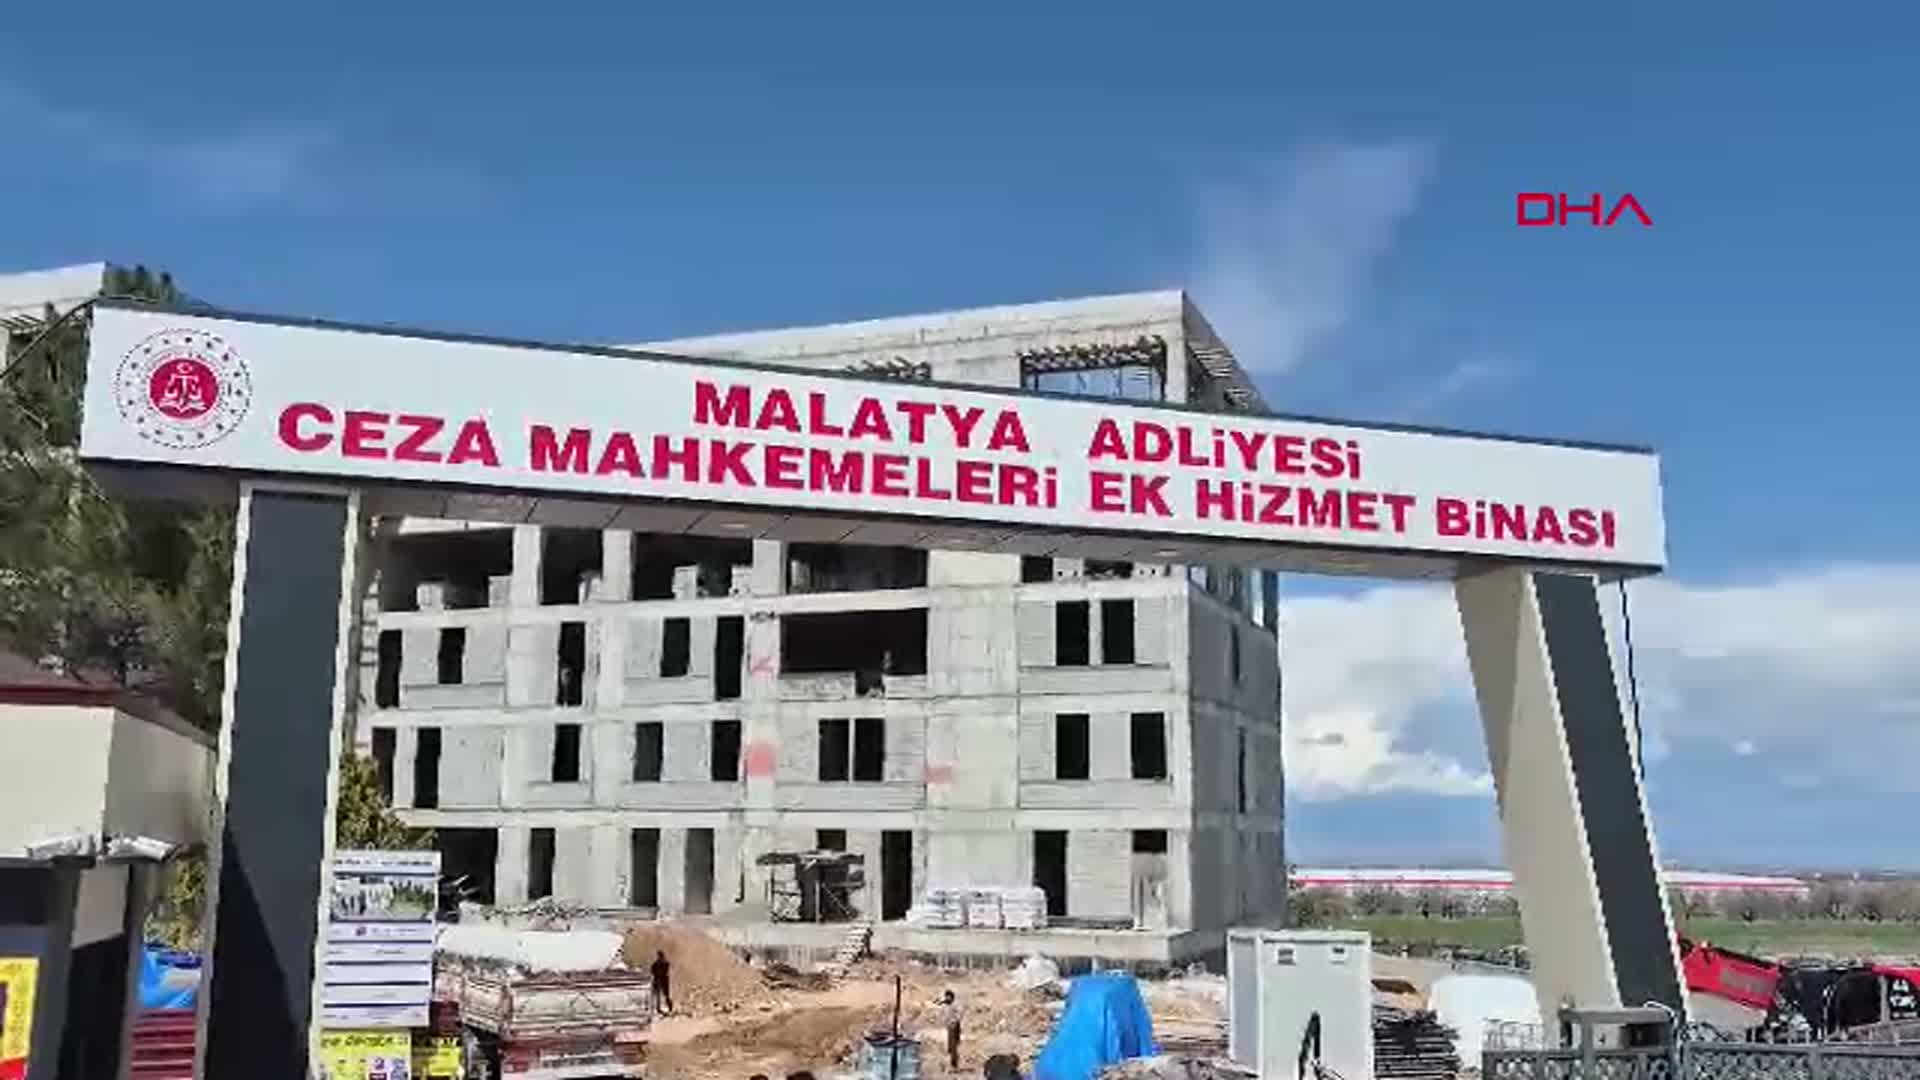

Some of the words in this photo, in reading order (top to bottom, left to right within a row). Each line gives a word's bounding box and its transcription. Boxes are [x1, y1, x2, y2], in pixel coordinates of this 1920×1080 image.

[277, 403, 498, 468] CEZA
[1089, 470, 1170, 519] EK
[693, 380, 1029, 455] MALATYA
